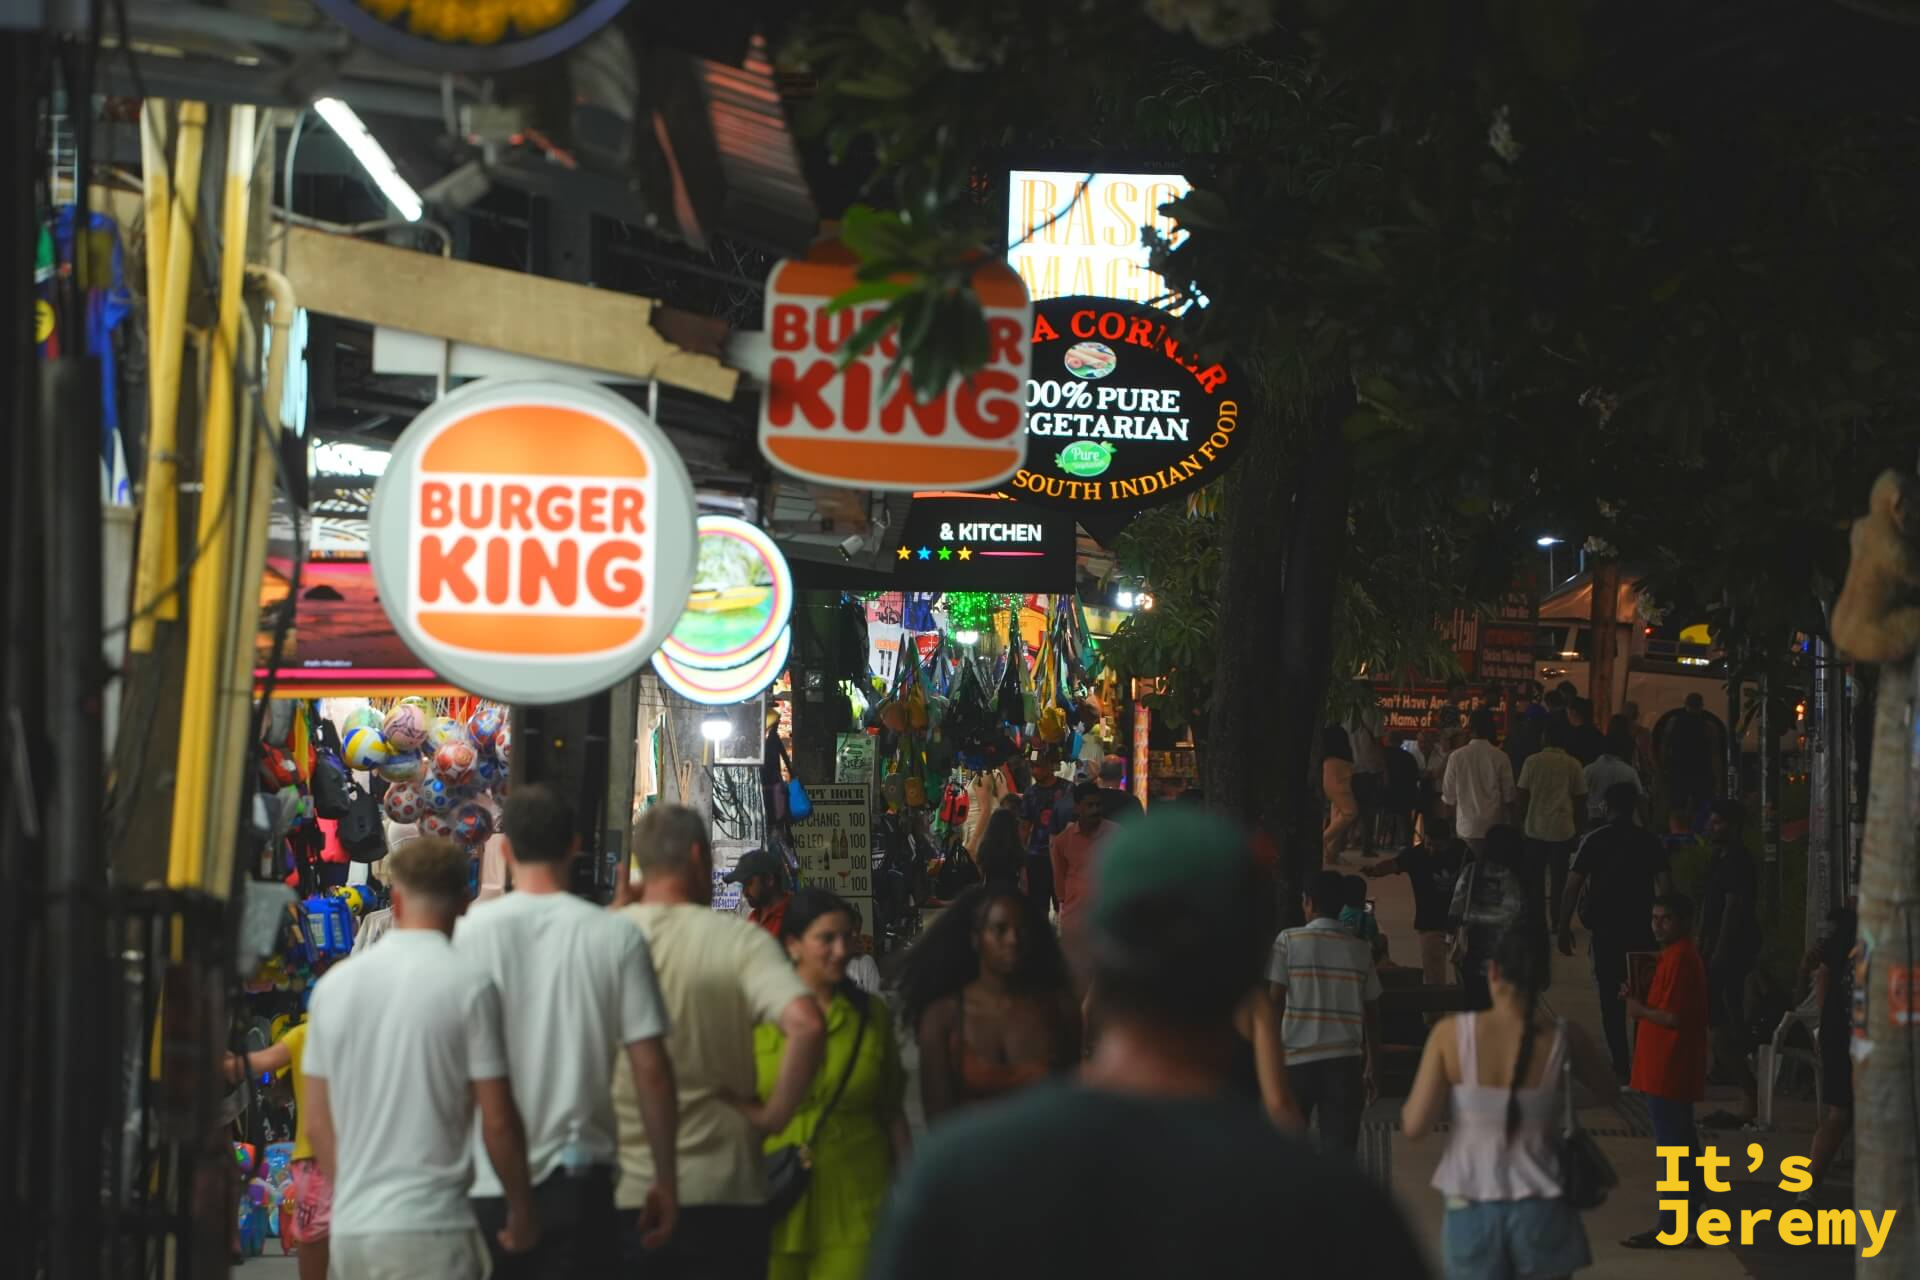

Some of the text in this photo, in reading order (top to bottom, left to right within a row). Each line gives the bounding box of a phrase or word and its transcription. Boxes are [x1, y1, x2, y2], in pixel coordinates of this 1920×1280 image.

[1018, 256, 1182, 316] MAGI
[771, 303, 1024, 367] BURR
[767, 356, 1021, 441] KING
[1024, 379, 1181, 413] 00% PURE
[1023, 411, 1190, 441] GETARIAN
[1012, 400, 1238, 501] SOUTH INDIAN FOOD
[1072, 446, 1100, 461] Pure
[420, 481, 646, 534] BURGER
[939, 523, 1042, 542] & KITCHEN
[418, 535, 645, 608] KING
[878, 649, 892, 677] 11
[1403, 694, 1428, 710] Have
[1391, 711, 1418, 726] Name
[1421, 710, 1432, 727] of
[831, 788, 864, 799] HOUR
[849, 812, 865, 827] 100
[850, 833, 866, 848] 100
[851, 855, 867, 870] 100
[851, 876, 867, 891] 100
